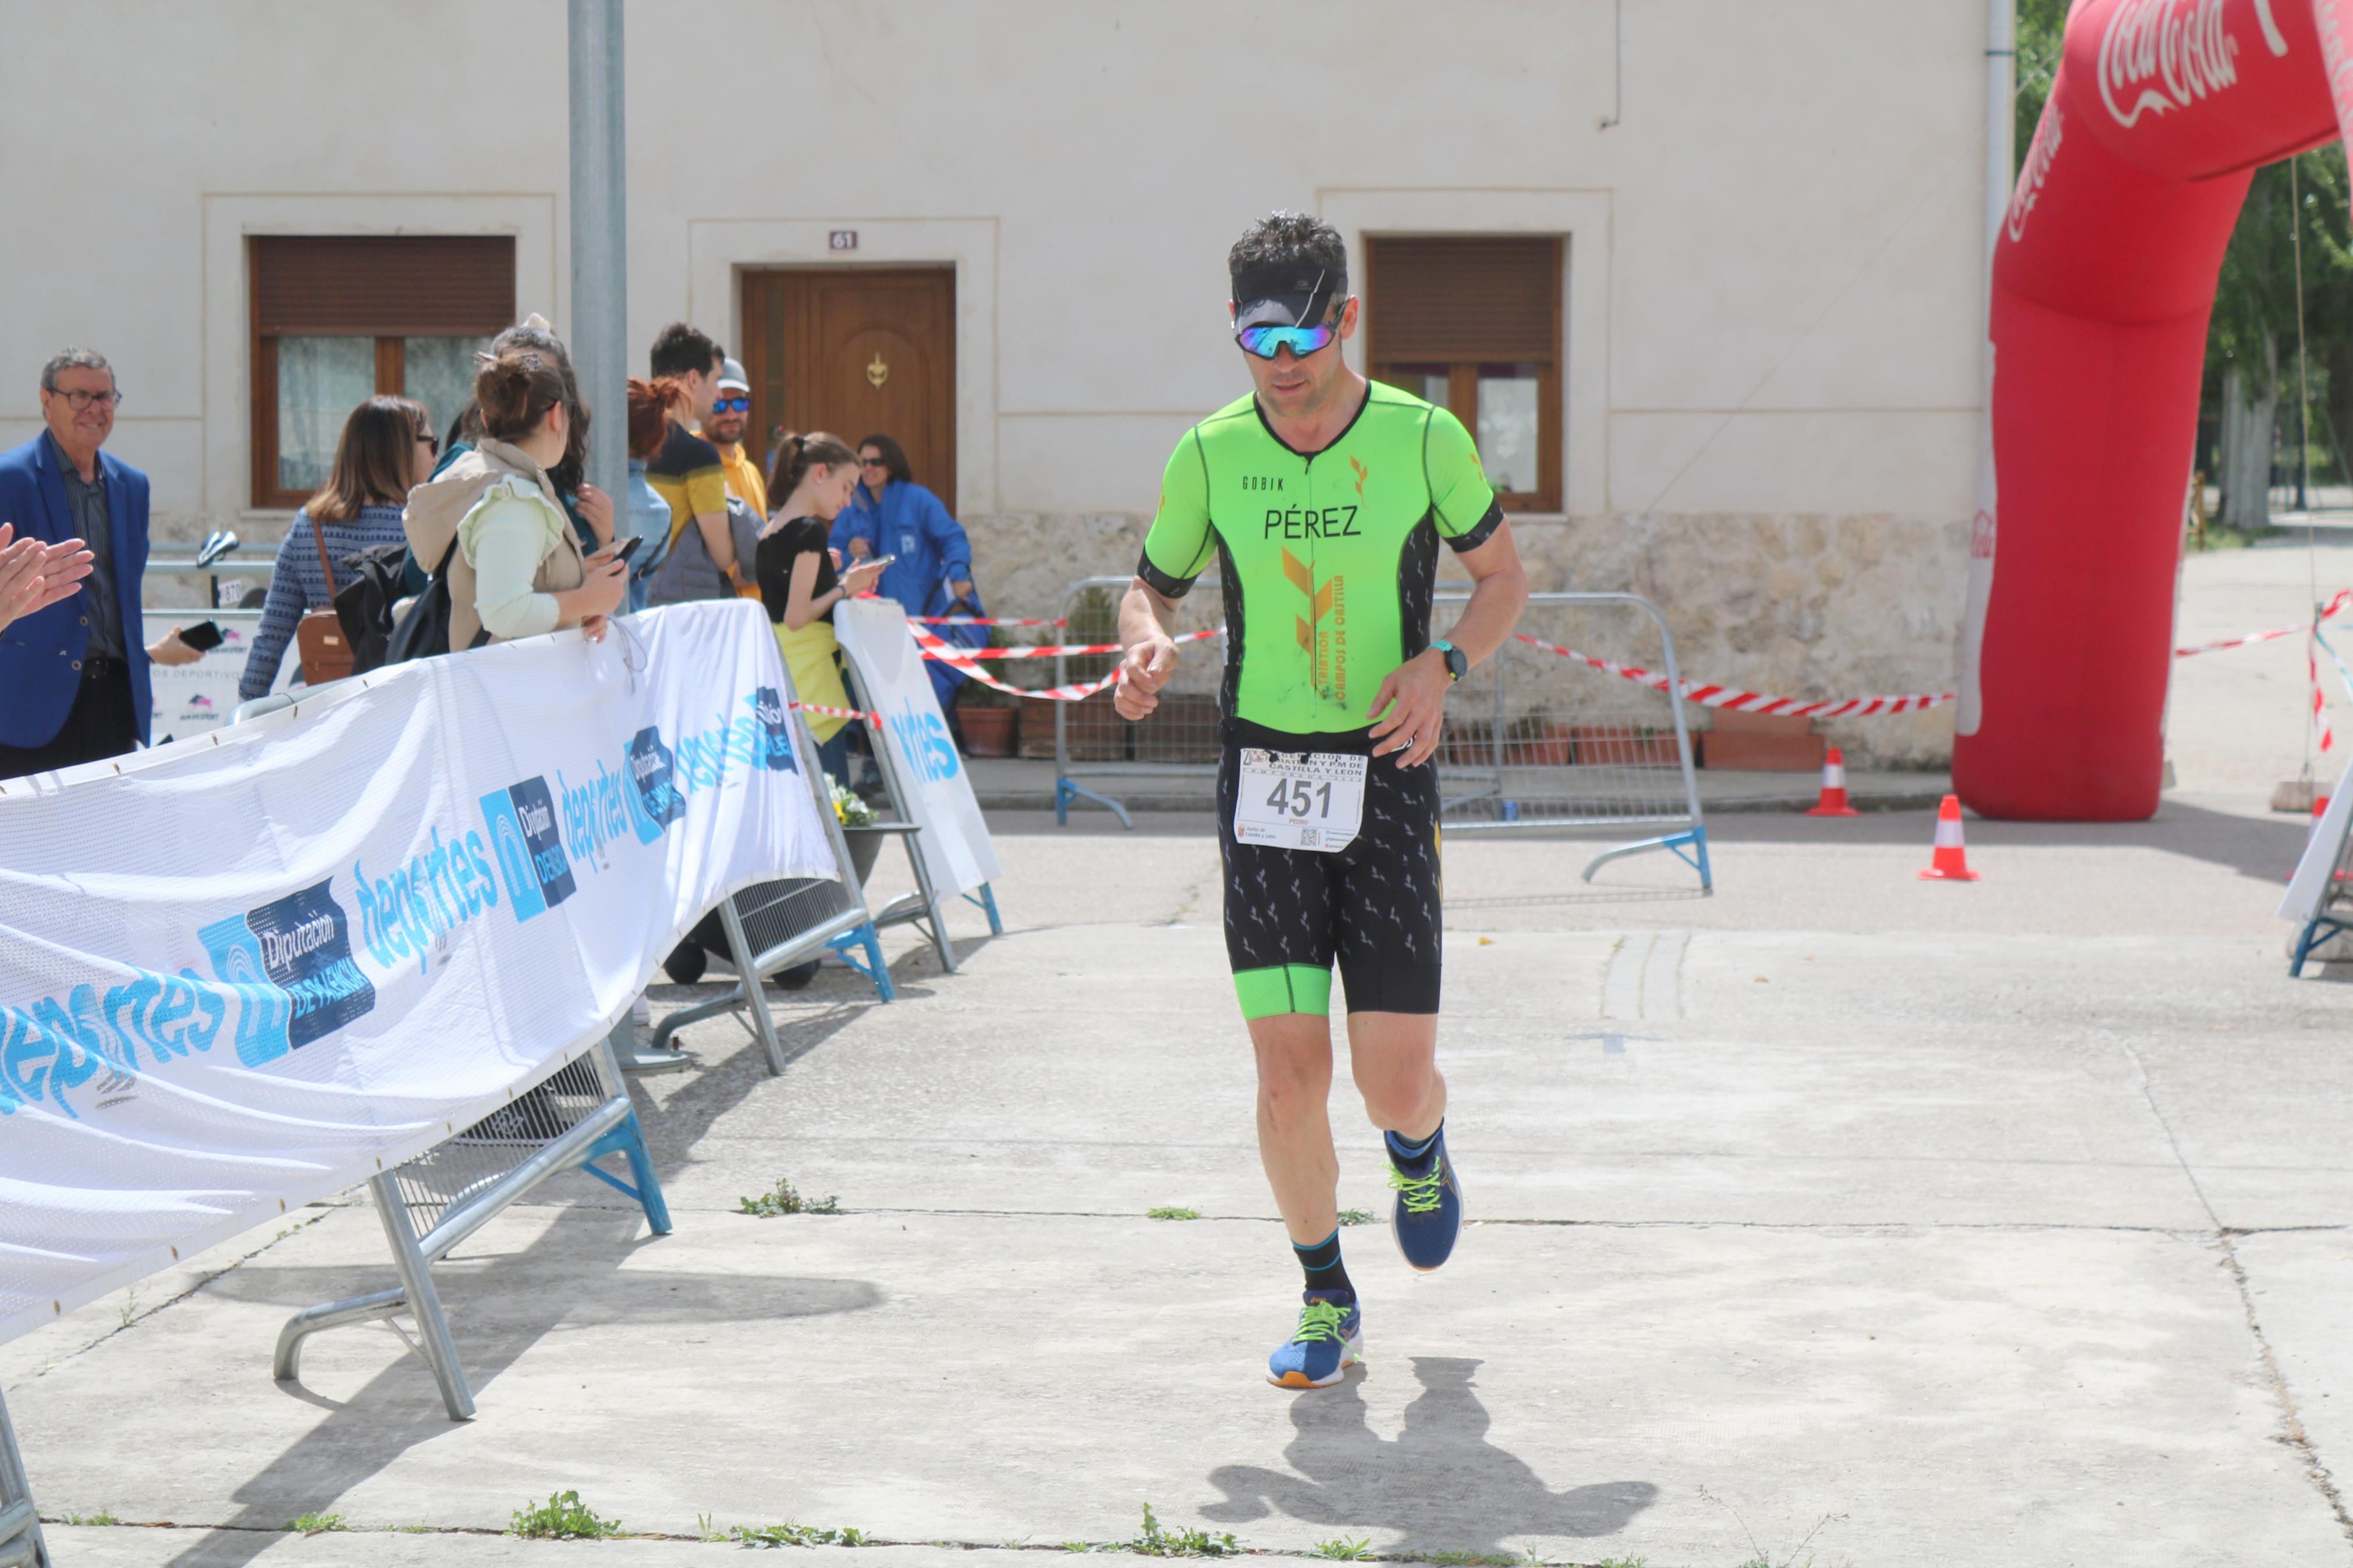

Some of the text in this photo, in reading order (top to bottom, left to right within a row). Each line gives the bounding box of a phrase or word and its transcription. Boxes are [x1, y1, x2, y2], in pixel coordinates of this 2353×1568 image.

[831, 232, 857, 249] 61
[1243, 476, 1283, 491] GOBIK
[1265, 504, 1361, 539] PÉREZ
[1318, 631, 1329, 684] TRIATLON
[1334, 575, 1346, 701] CAMPOS DE CASTILLA
[1269, 763, 1321, 773] CASTILLA
[1266, 777, 1332, 819] 451
[354, 826, 497, 976] deportes
[264, 910, 334, 972] Diputación
